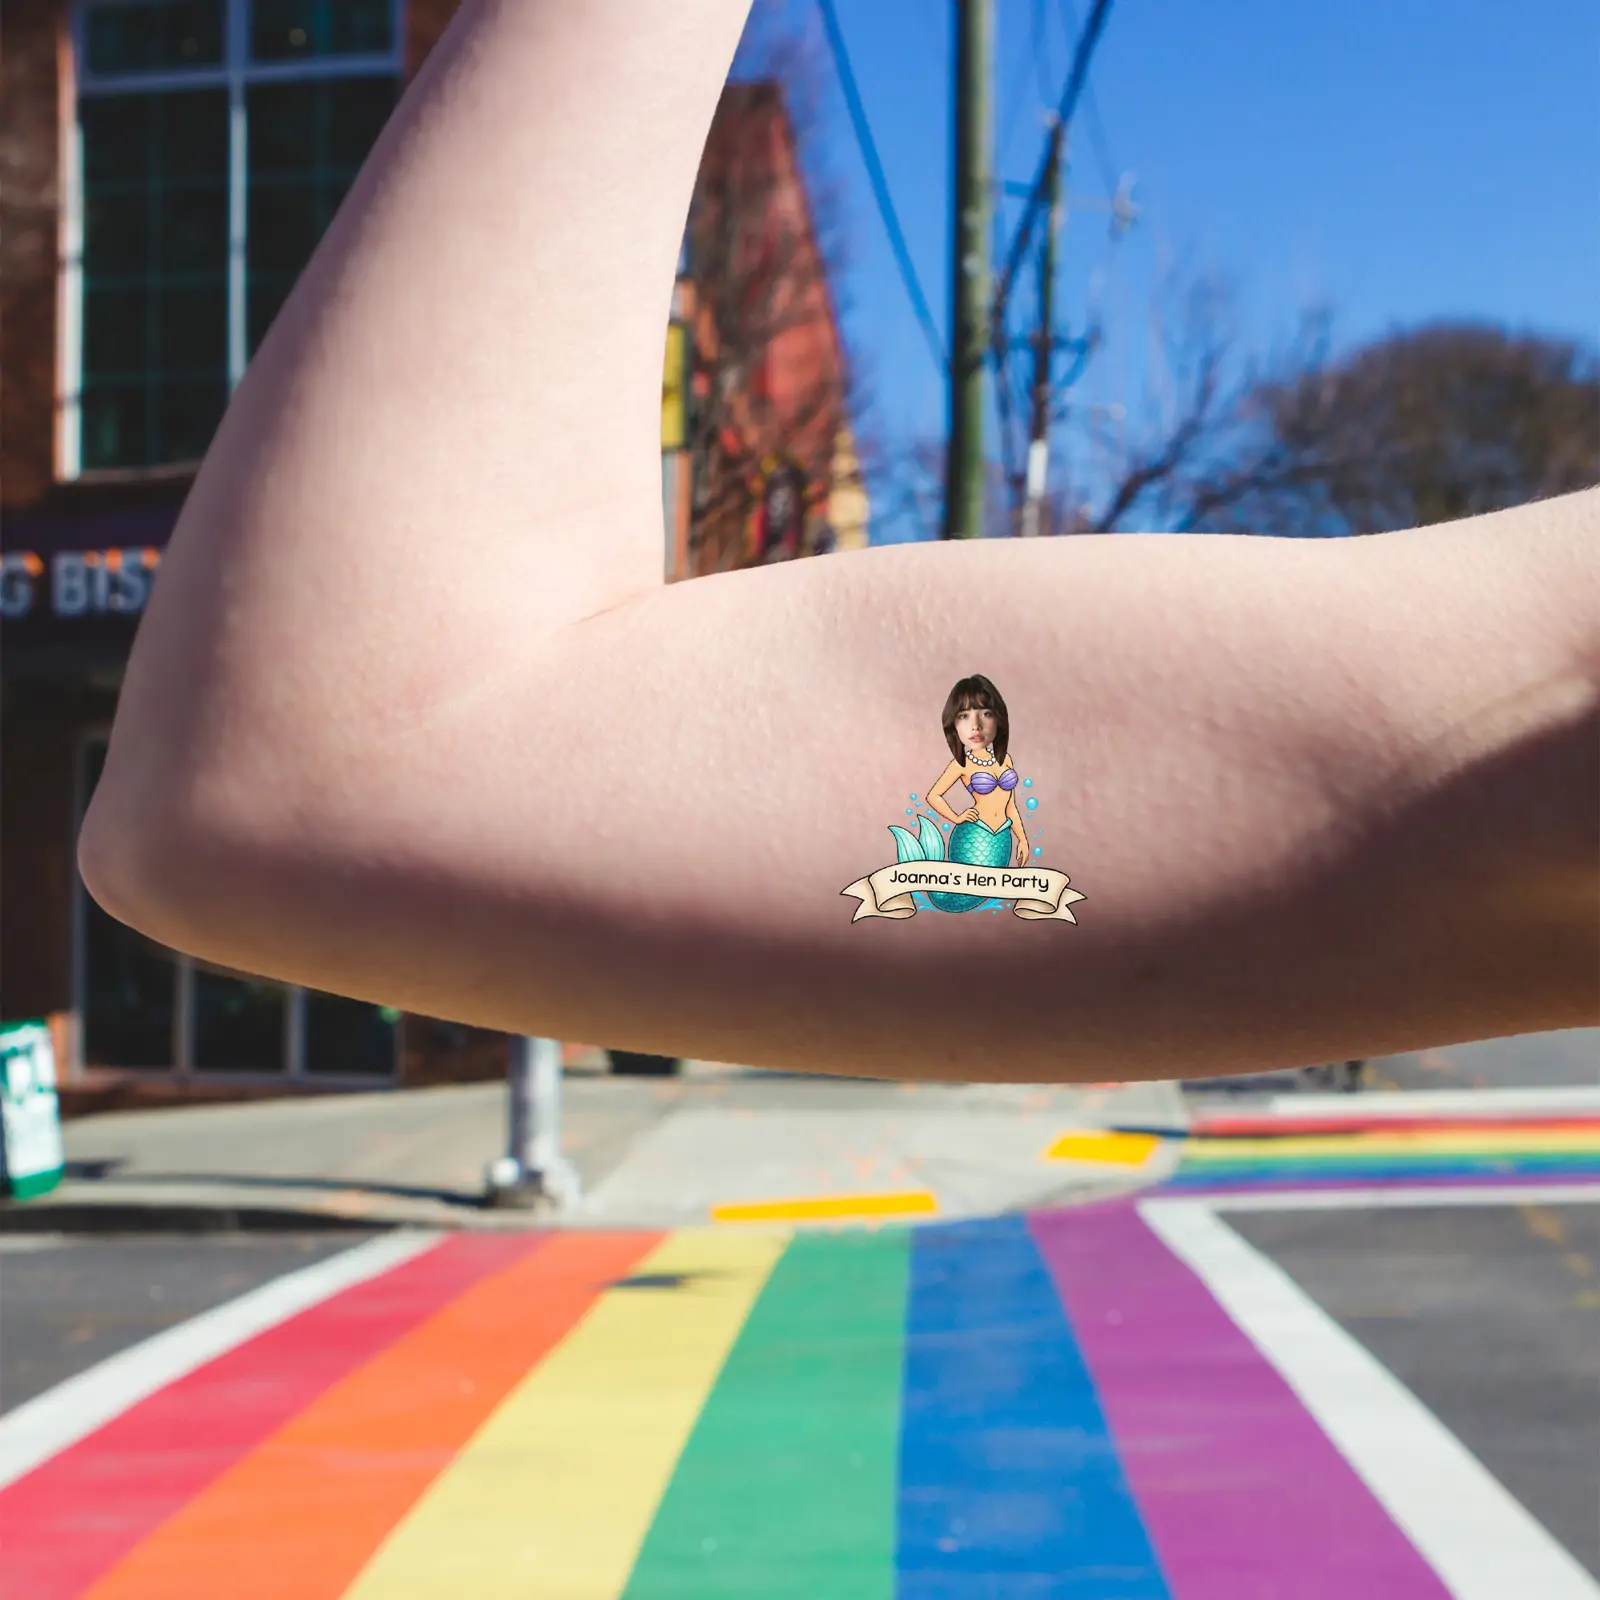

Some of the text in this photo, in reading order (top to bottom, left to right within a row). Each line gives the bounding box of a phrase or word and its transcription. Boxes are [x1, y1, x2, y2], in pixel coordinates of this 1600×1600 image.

[890, 870, 1050, 892] Joanna's Hen Party
